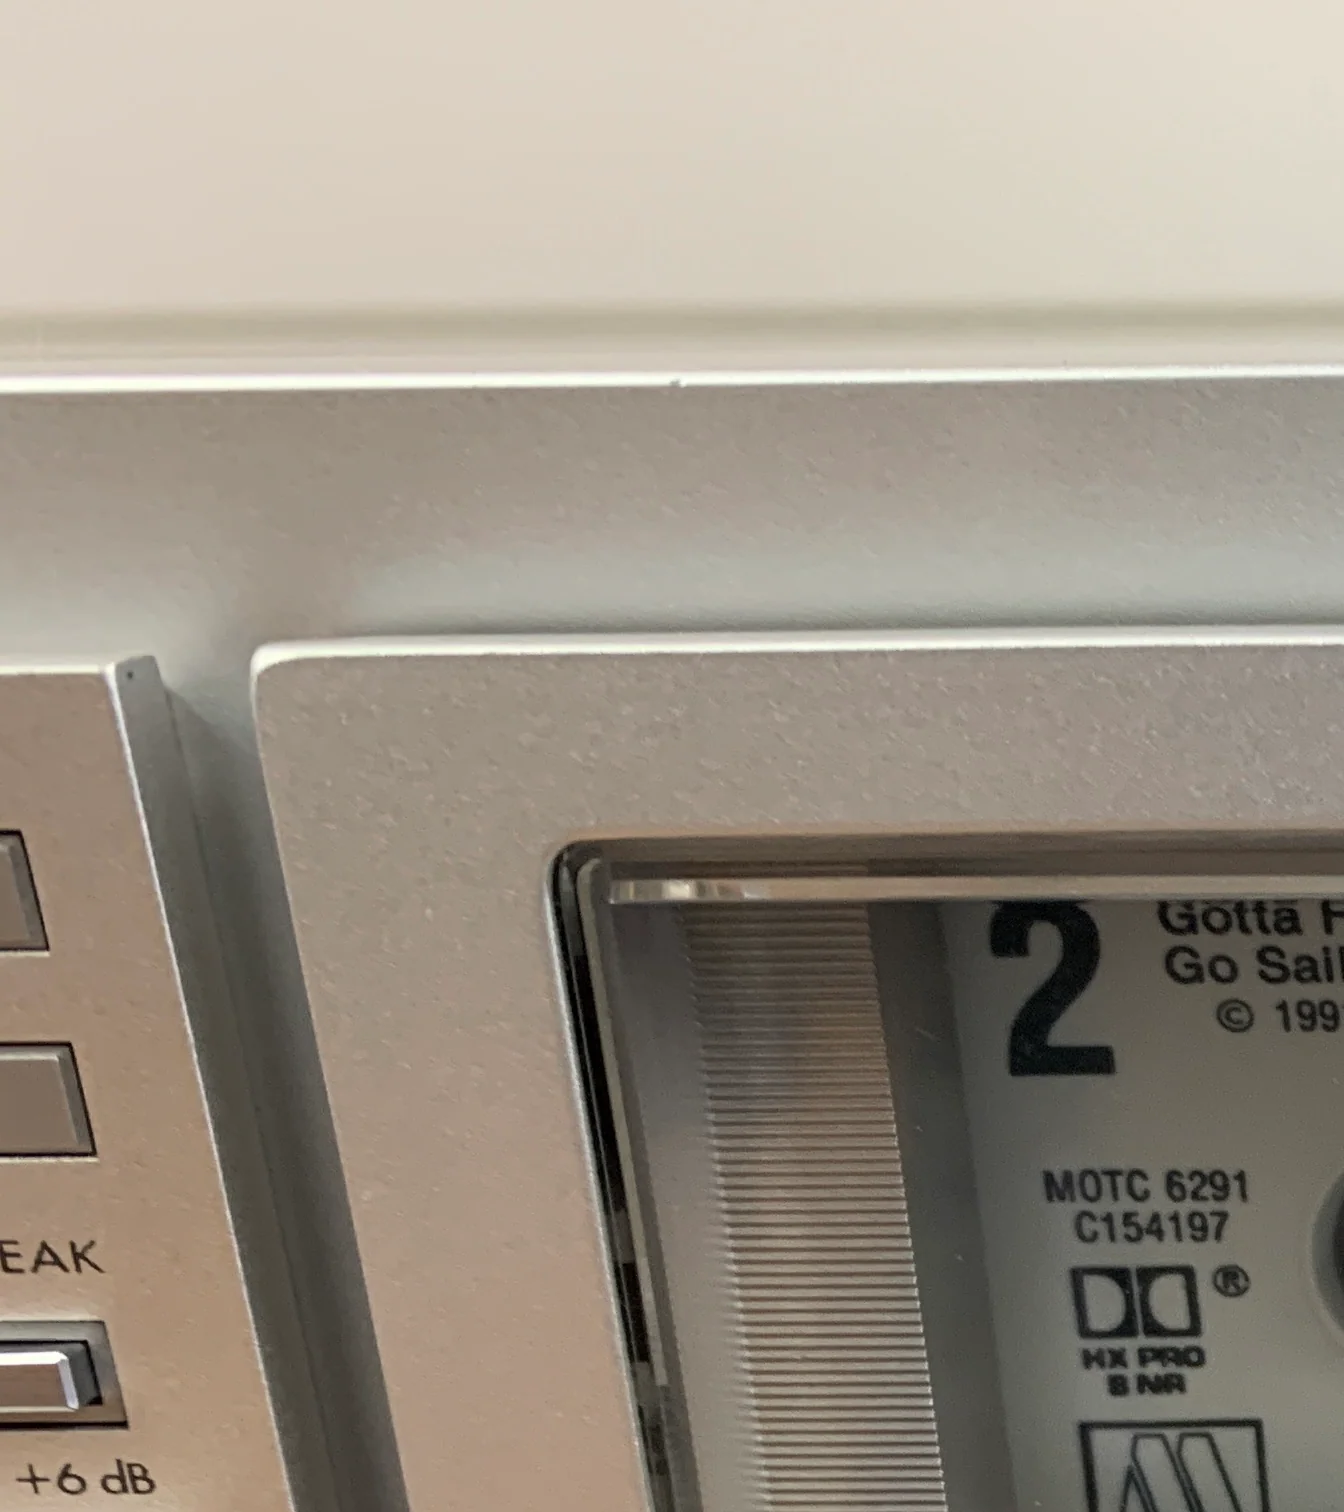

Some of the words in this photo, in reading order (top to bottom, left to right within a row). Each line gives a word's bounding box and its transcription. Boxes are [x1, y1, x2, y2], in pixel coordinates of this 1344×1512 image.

[1157, 898, 1303, 936] Gotta
[1164, 945, 1239, 985] Go
[988, 898, 1116, 1077] 2
[1042, 1169, 1151, 1203] MOTC
[1165, 1169, 1249, 1202] 6291
[1074, 1210, 1229, 1244] C154197
[1081, 1347, 1128, 1369] HX
[1138, 1347, 1205, 1369] PRO
[1136, 1373, 1187, 1394] NR
[16, 1463, 87, 1495] +6
[100, 1458, 157, 1495] dB
